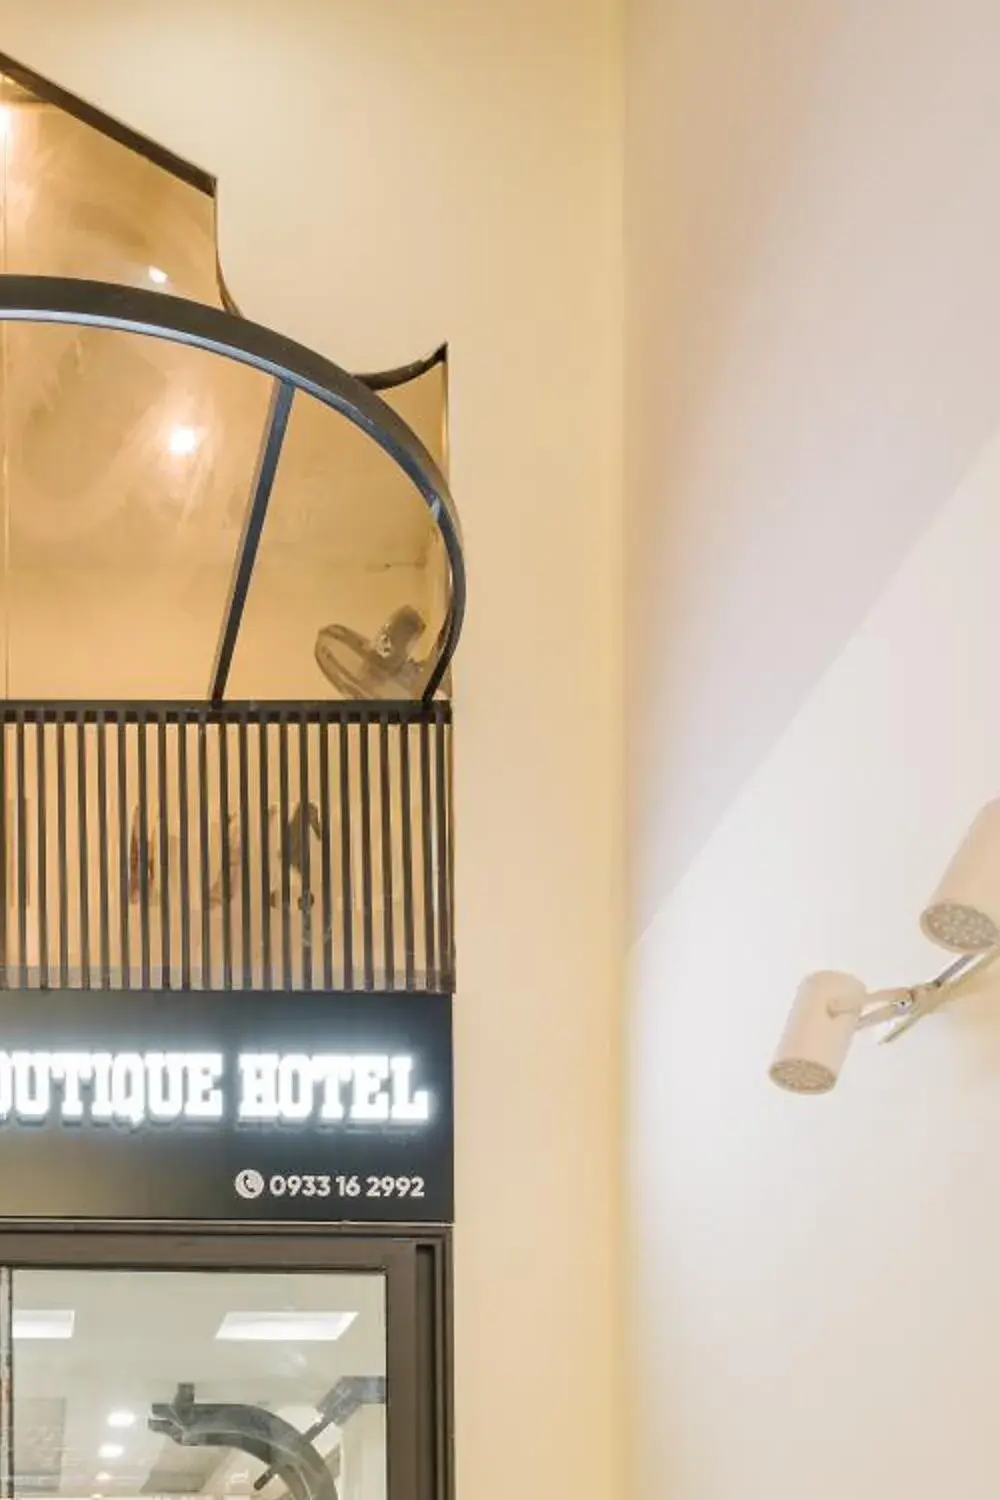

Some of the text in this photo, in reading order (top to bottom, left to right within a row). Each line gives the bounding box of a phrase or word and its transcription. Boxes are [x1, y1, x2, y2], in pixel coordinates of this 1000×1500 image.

[238, 1053, 430, 1120] HOTEL
[269, 1174, 426, 1198] 0933 16 2992
